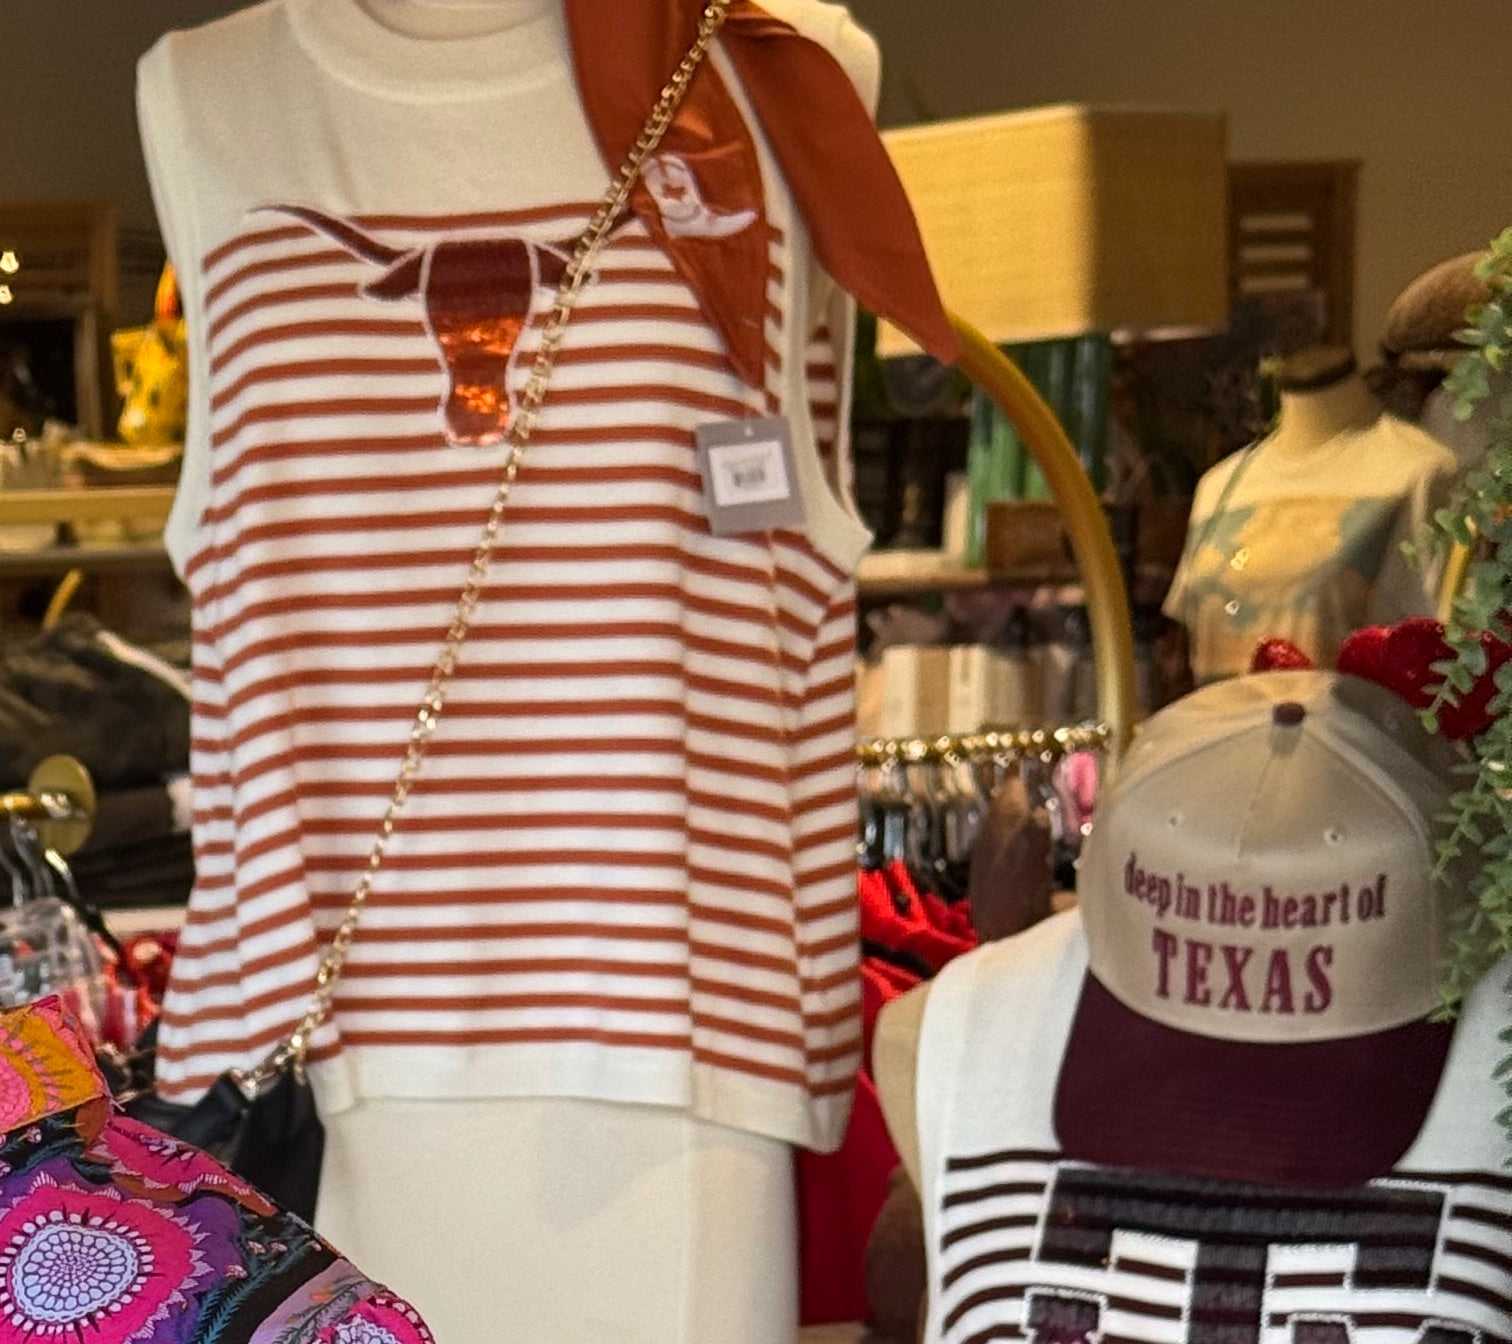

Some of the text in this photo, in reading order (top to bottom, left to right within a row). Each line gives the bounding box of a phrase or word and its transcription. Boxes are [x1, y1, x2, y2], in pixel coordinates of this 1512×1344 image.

[1124, 852, 1386, 930] deep in the heart of
[1153, 927, 1334, 1014] TEXAS
